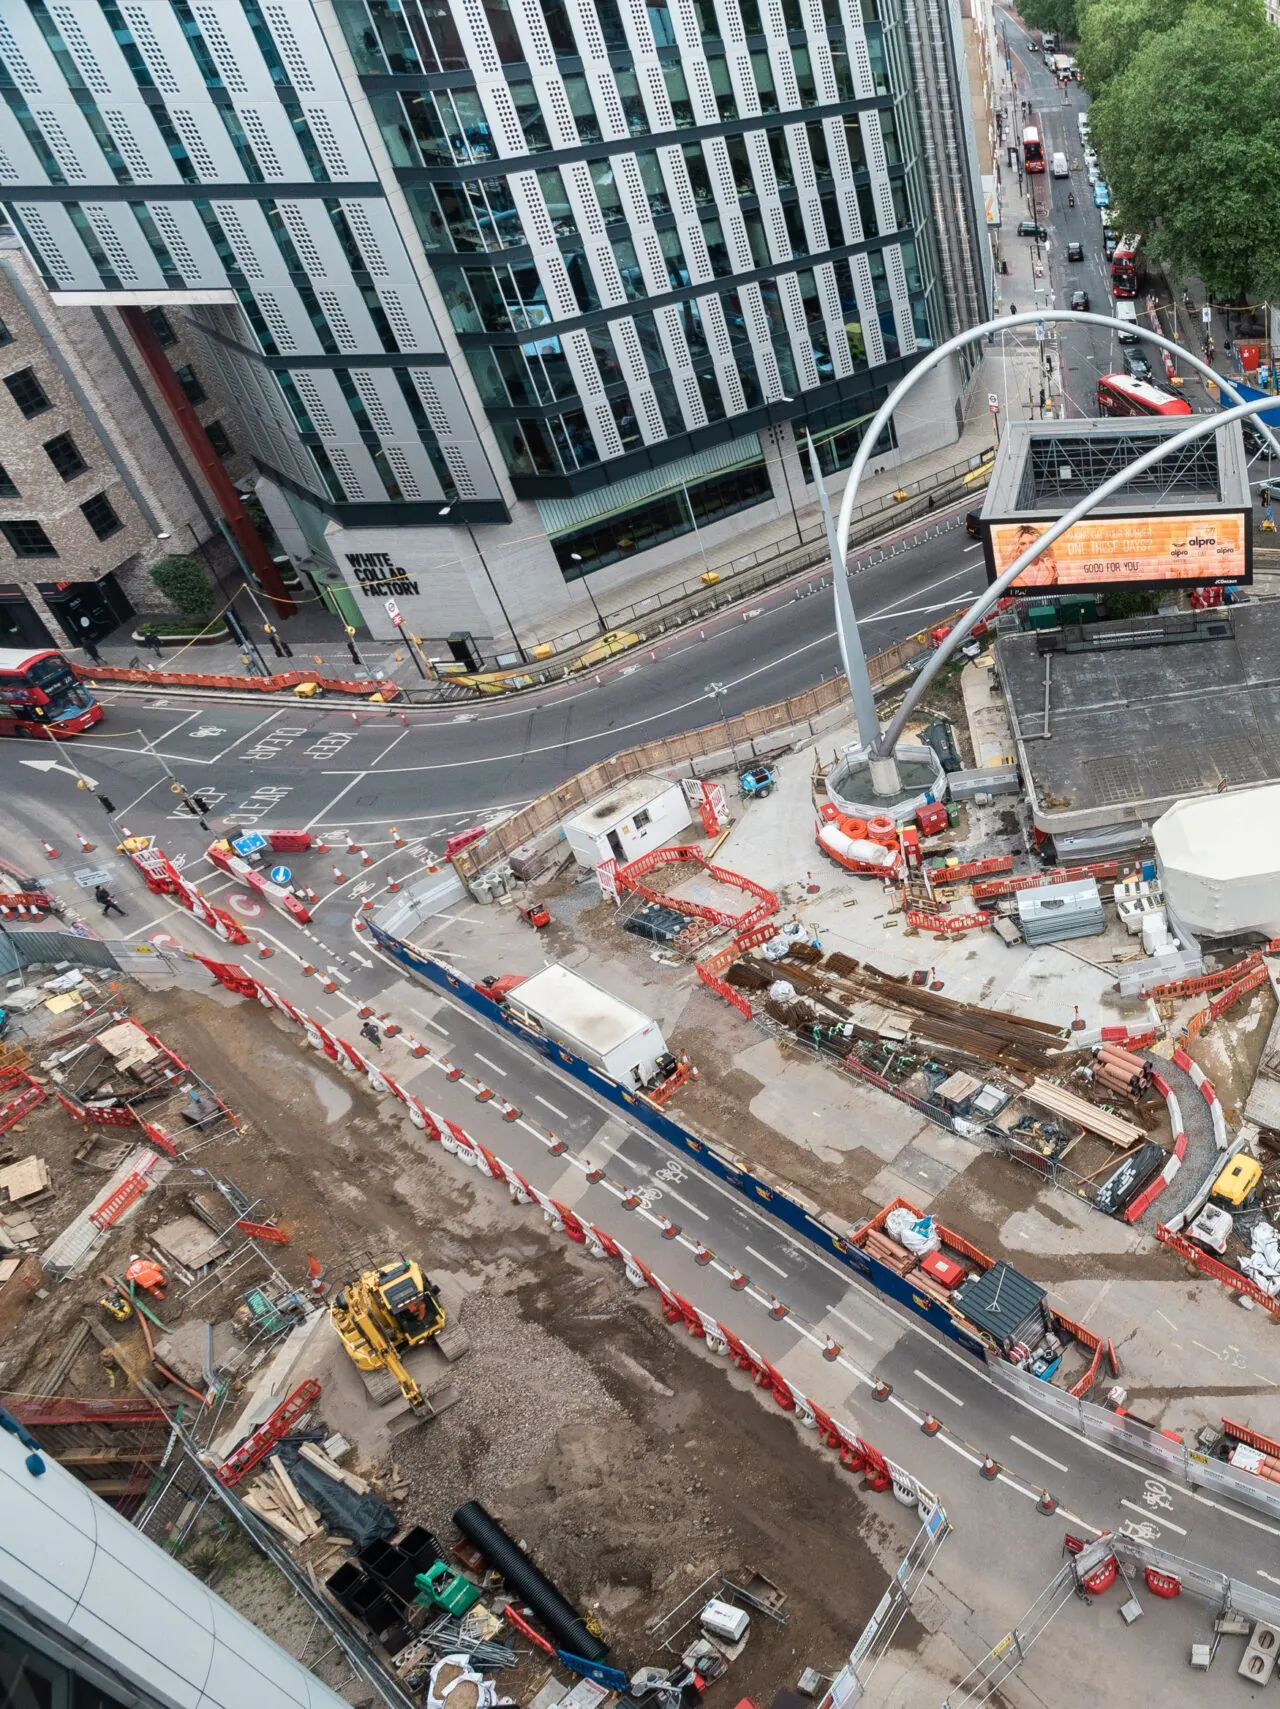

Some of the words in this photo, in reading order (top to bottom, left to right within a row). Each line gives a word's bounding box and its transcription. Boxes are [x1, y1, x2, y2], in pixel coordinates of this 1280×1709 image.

[1188, 536, 1216, 549] alpro
[1170, 549, 1188, 558] alpro
[1216, 546, 1234, 556] alpro
[344, 552, 394, 568] WHITE
[1083, 561, 1104, 574] GOOD
[1106, 560, 1121, 573] FOR
[1123, 560, 1139, 572] YOU
[353, 567, 410, 583] COLLAR
[361, 581, 421, 597] FACTORY
[239, 727, 307, 760] CLEAR
[303, 732, 358, 760] KEEP
[223, 786, 294, 825] CLEAR
